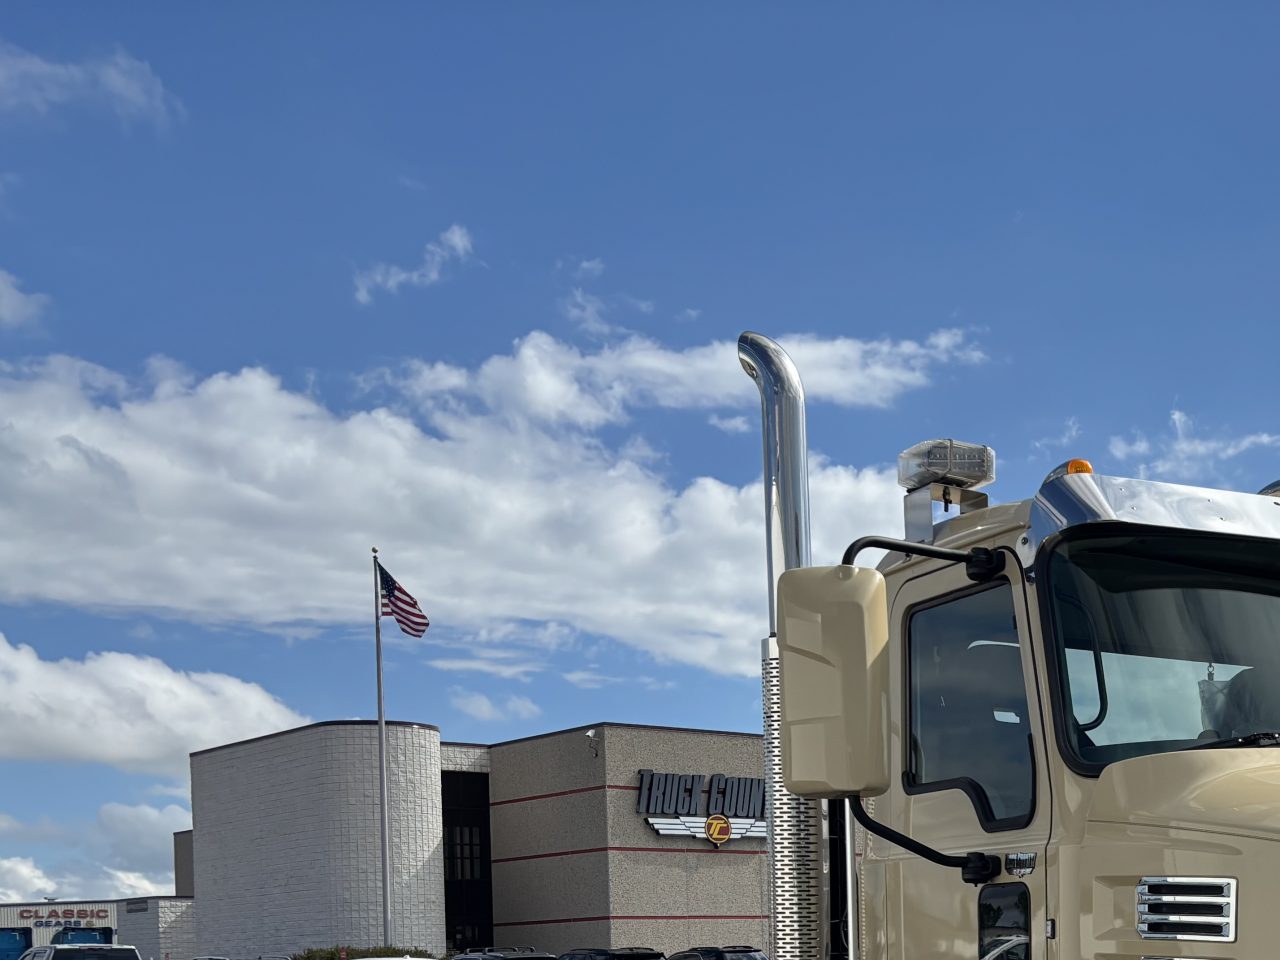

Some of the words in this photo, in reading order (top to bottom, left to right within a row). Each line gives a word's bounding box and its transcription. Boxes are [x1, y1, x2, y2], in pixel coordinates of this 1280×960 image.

[636, 769, 706, 815] TRUCK
[707, 773, 766, 817] COUN
[19, 909, 109, 919] CLASSIC
